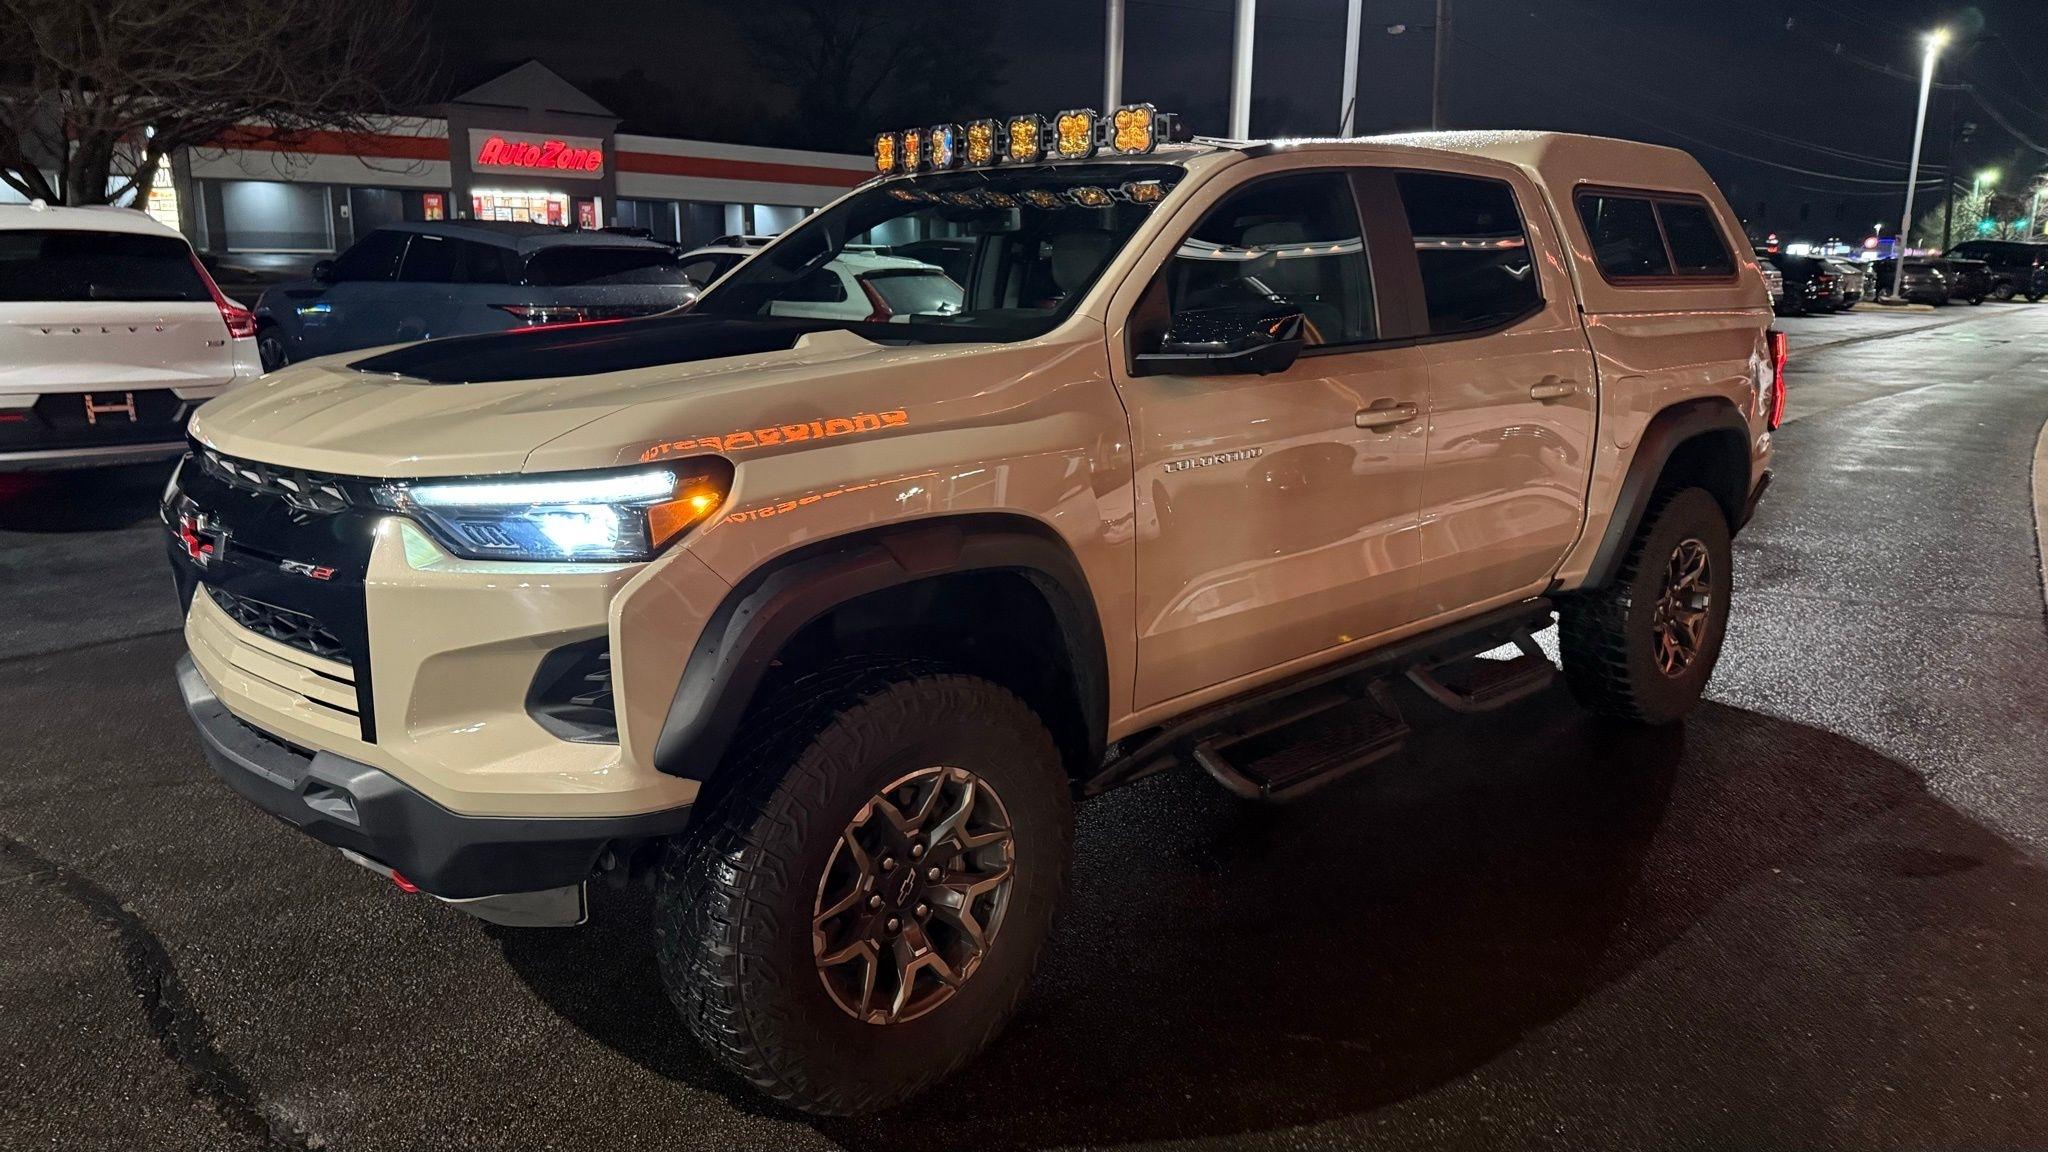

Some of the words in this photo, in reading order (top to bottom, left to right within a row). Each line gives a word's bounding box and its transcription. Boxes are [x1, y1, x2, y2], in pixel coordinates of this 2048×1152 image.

[478, 135, 603, 171] AutoZone
[41, 325, 164, 335] VOLVO
[1164, 447, 1263, 473] COLORADO
